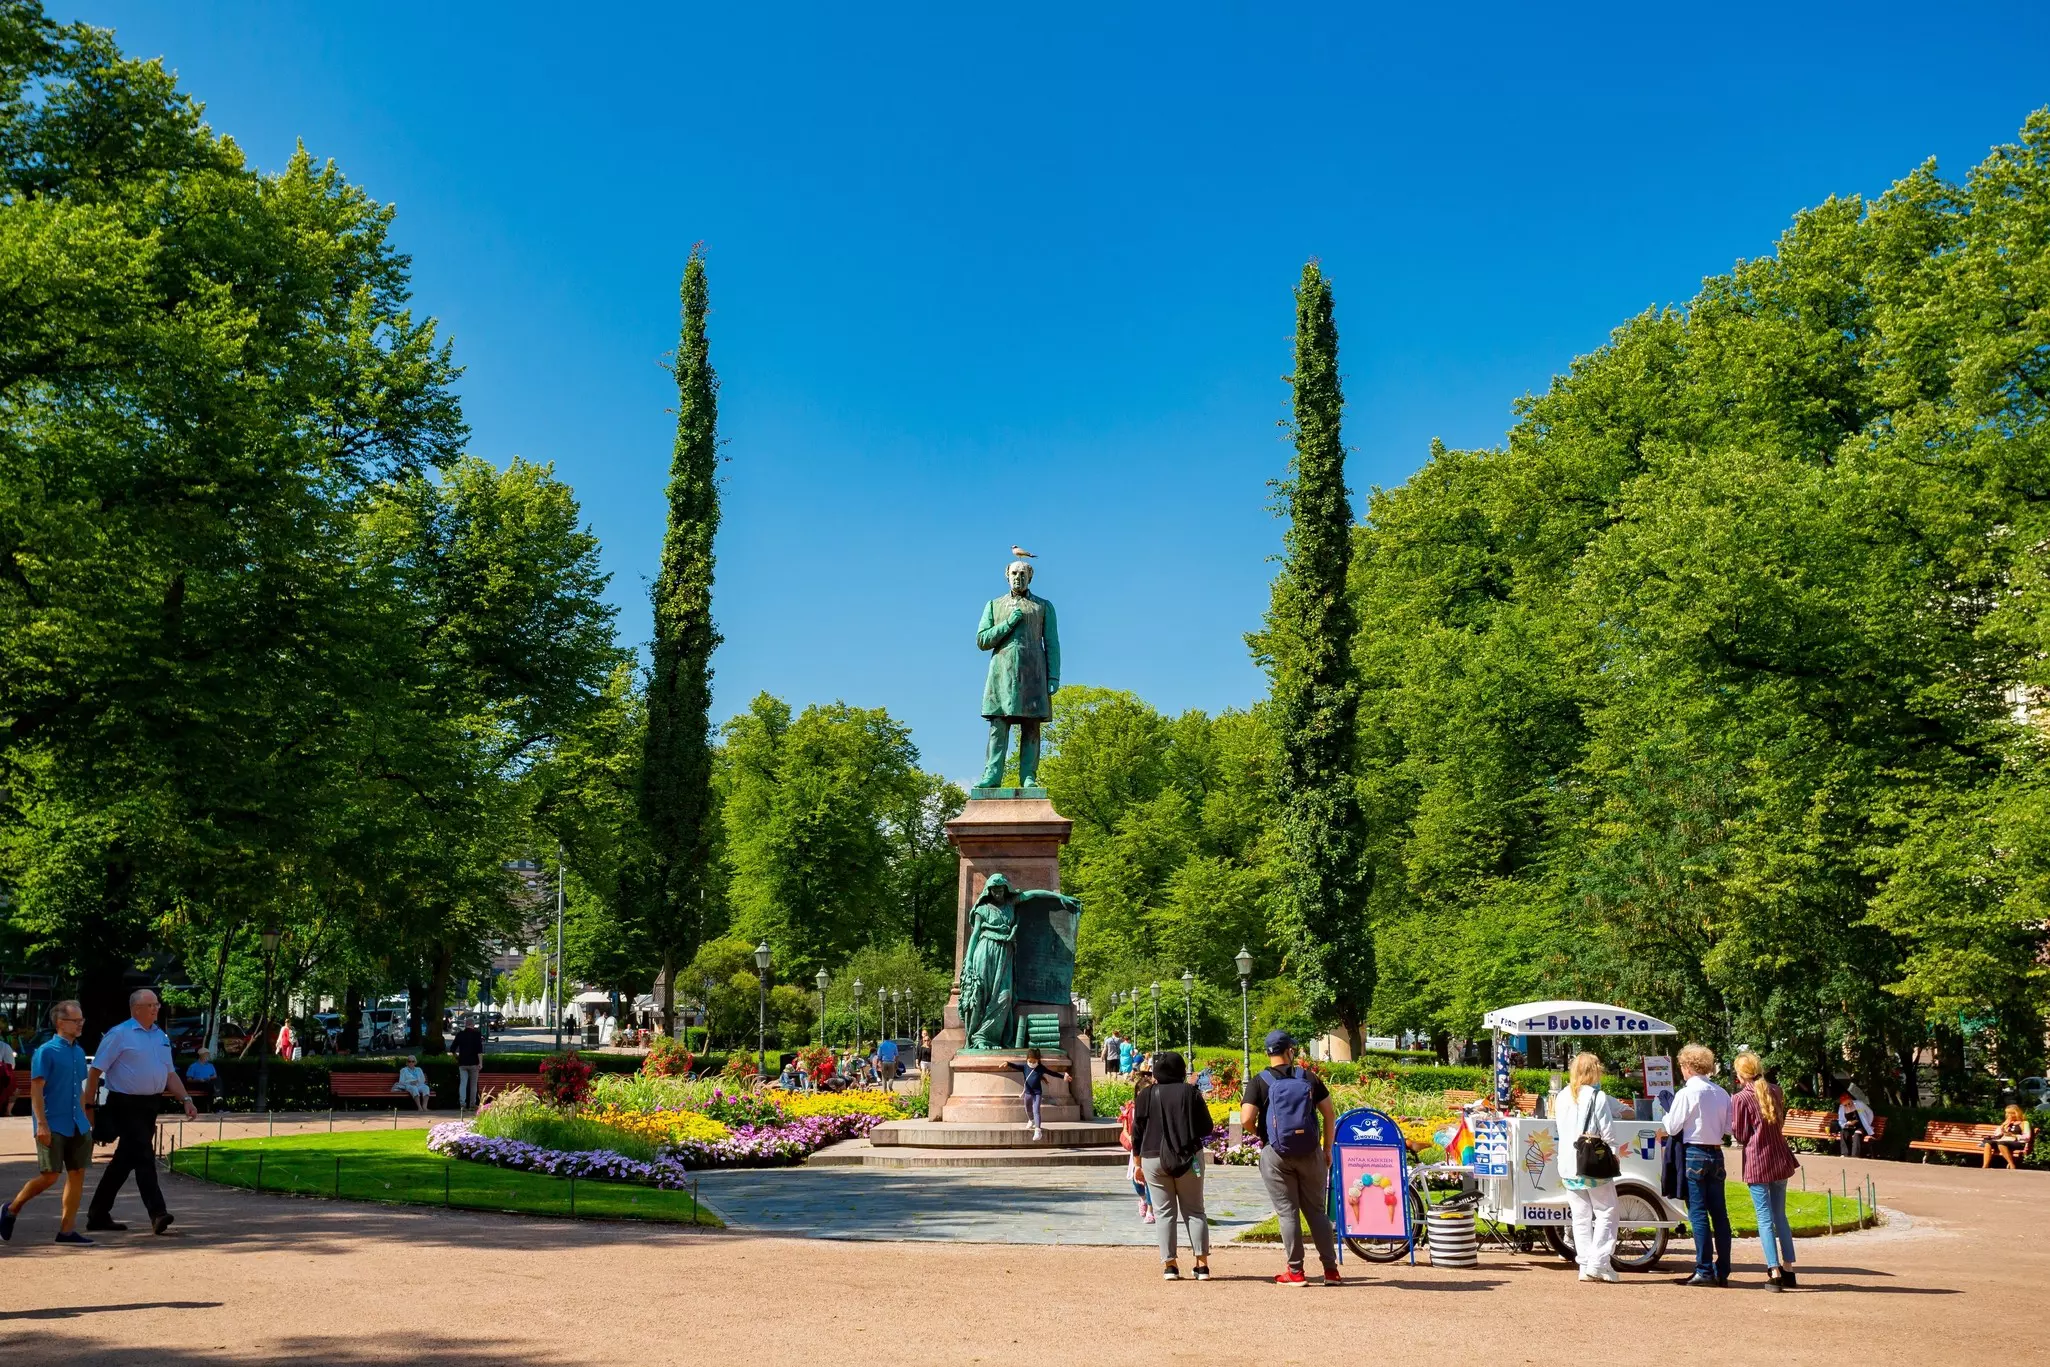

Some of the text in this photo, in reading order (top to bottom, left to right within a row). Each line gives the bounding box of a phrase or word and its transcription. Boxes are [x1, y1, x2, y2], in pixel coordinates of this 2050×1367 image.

[1500, 1017, 1517, 1029] ream
[1547, 1014, 1649, 1031] Bubble Tea
